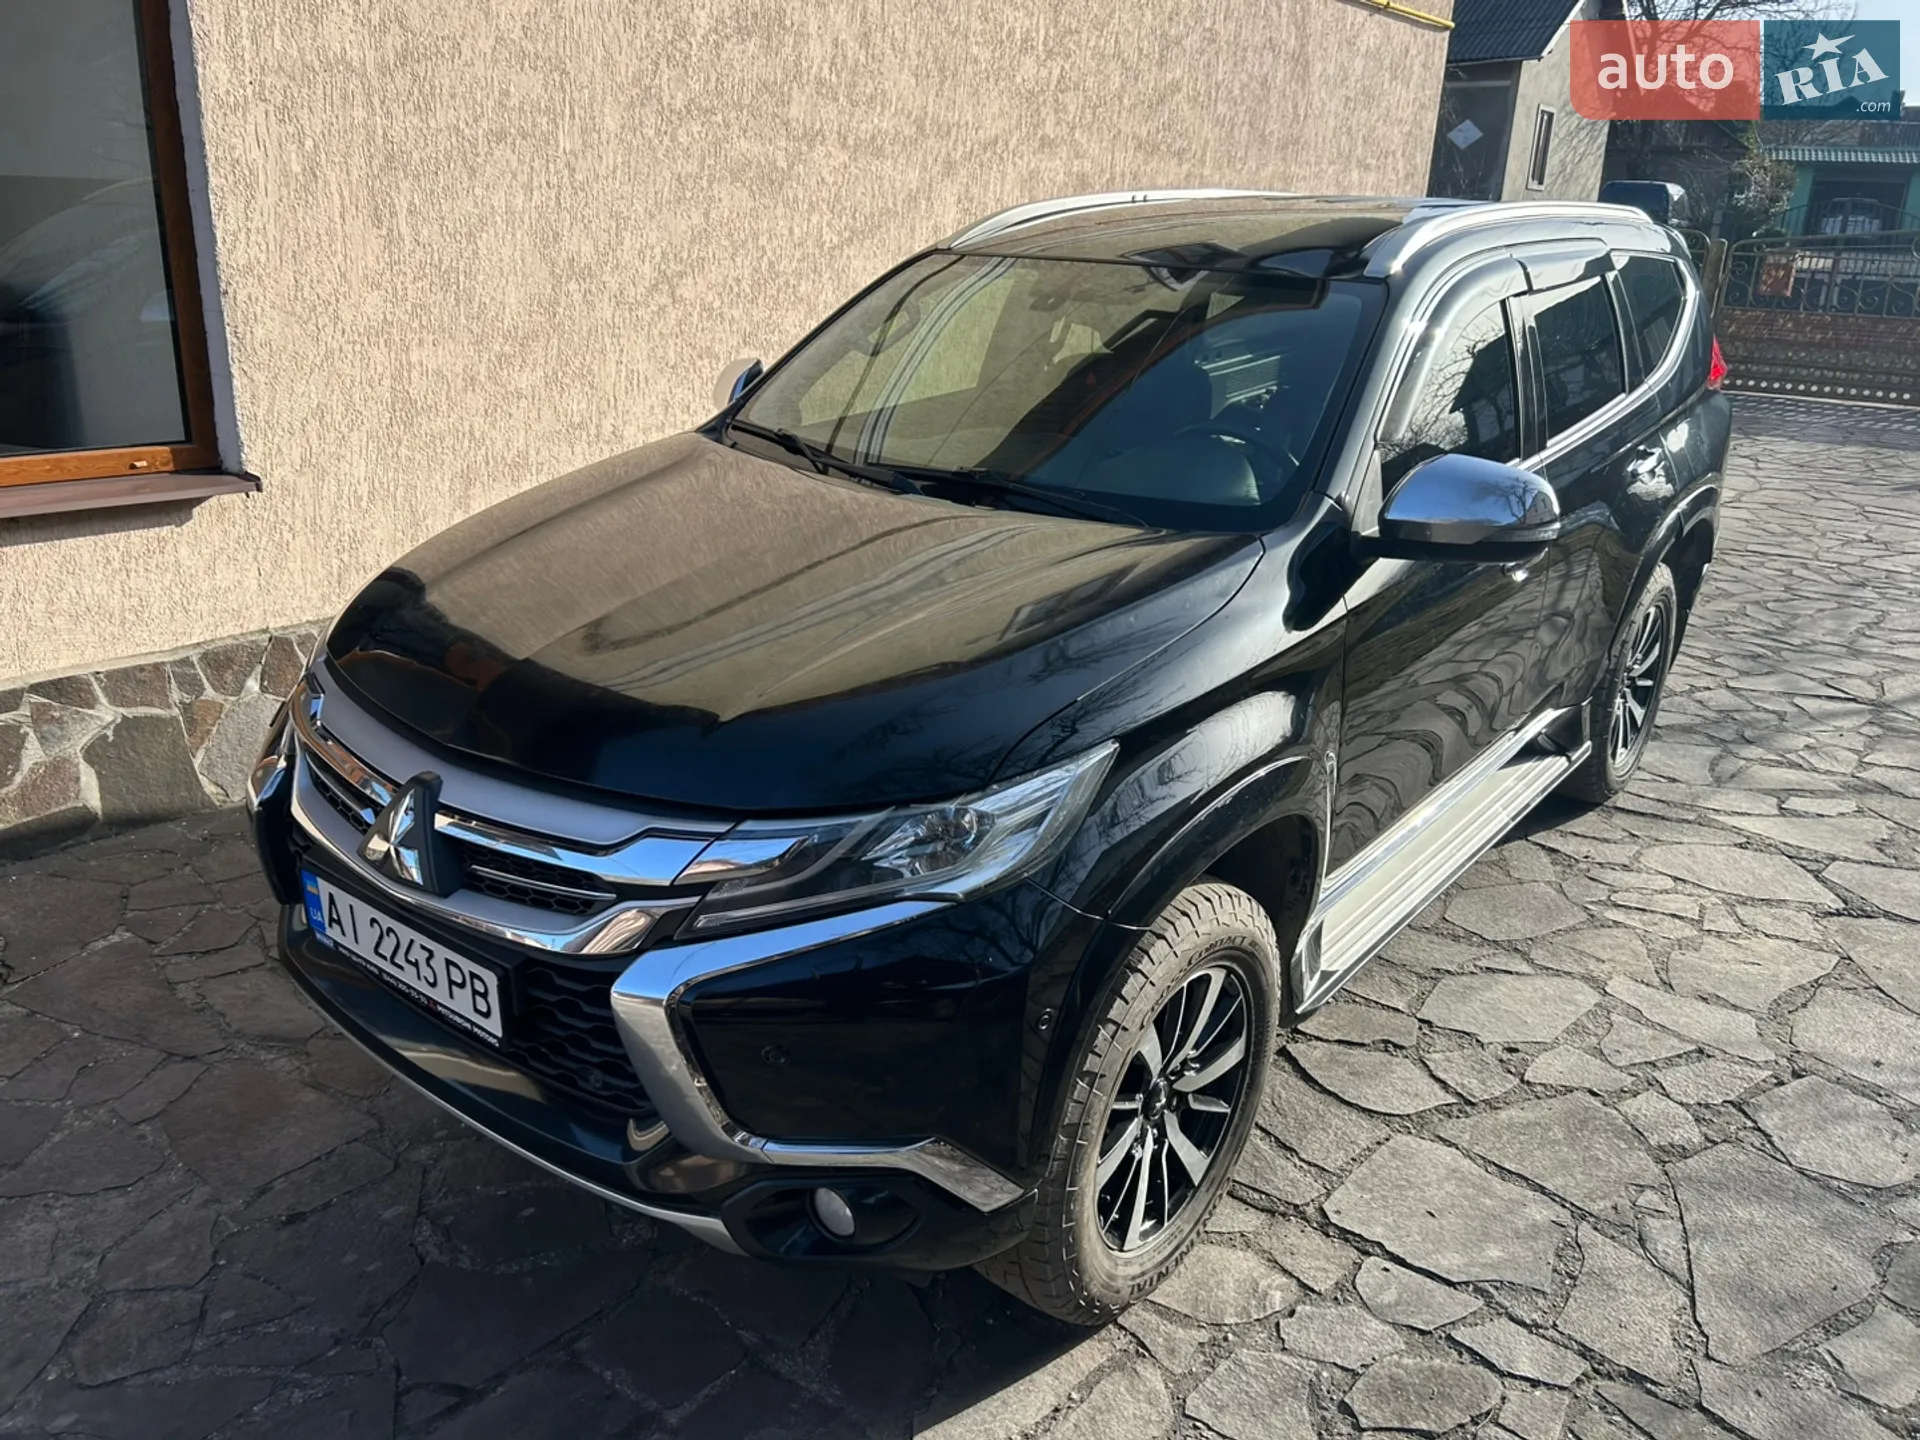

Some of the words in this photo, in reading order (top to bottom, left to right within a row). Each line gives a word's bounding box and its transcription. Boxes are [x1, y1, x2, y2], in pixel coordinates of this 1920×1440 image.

[310, 906, 324, 923] UA
[369, 917, 438, 988] 2243
[444, 956, 492, 1019] PB
